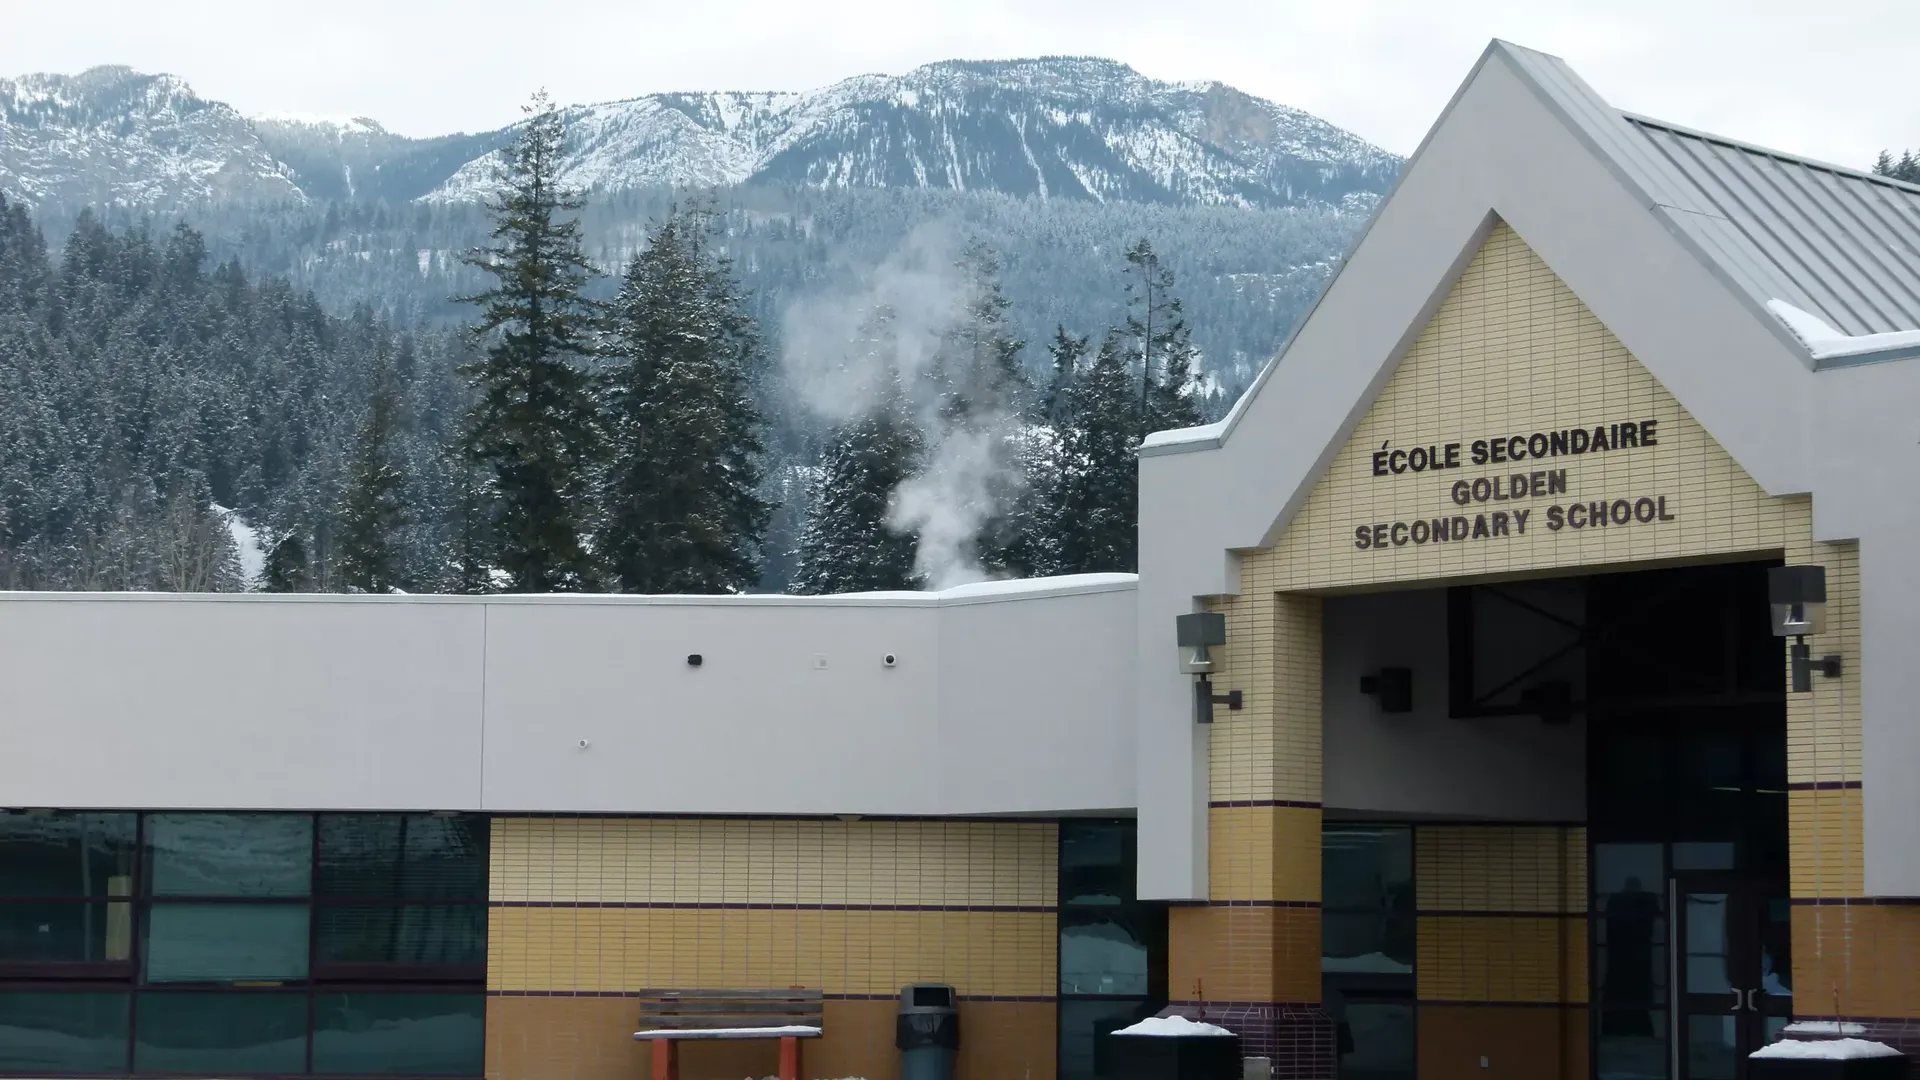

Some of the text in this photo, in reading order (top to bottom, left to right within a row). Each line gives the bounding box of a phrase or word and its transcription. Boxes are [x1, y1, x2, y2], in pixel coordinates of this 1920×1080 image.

[1372, 420, 1657, 476] ÉCOLE SECONDAIRE
[1451, 469, 1567, 505] GOLDEN
[1355, 496, 1675, 549] SECONDARY SCHOOL
